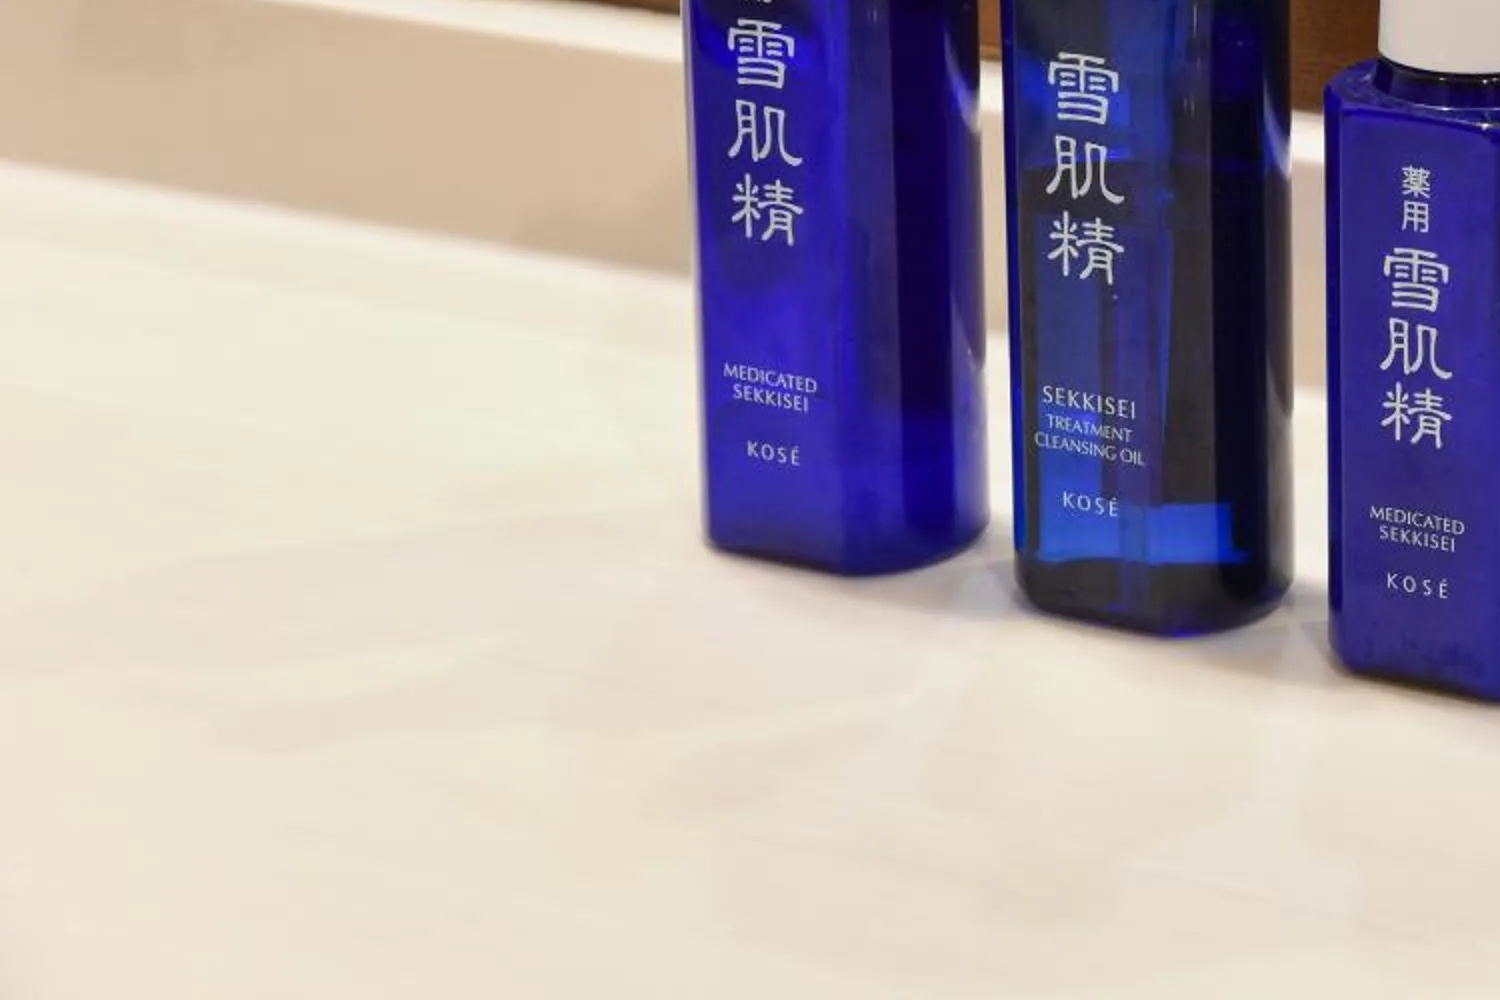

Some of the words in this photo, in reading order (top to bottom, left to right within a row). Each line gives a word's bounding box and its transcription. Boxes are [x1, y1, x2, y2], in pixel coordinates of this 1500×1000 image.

[726, 18, 803, 246] 雪肌精
[1045, 52, 1125, 285] 雪肌精
[1400, 165, 1432, 233] 薬用
[1379, 247, 1453, 450] 雪肌精
[723, 362, 818, 394] MEDICATED
[732, 383, 810, 413] SEKKISEI
[1042, 385, 1137, 420] SEKKISEI
[1046, 414, 1133, 443] TREATMENT
[746, 439, 801, 466] KOSÉ
[1034, 431, 1117, 462] CLEANSING
[1119, 447, 1146, 467] OIL
[1062, 490, 1119, 518] KOSÉ
[1369, 506, 1465, 536] MEDICATED
[1379, 524, 1457, 553] SEKKISEI
[1386, 572, 1449, 600] KOSÉ
